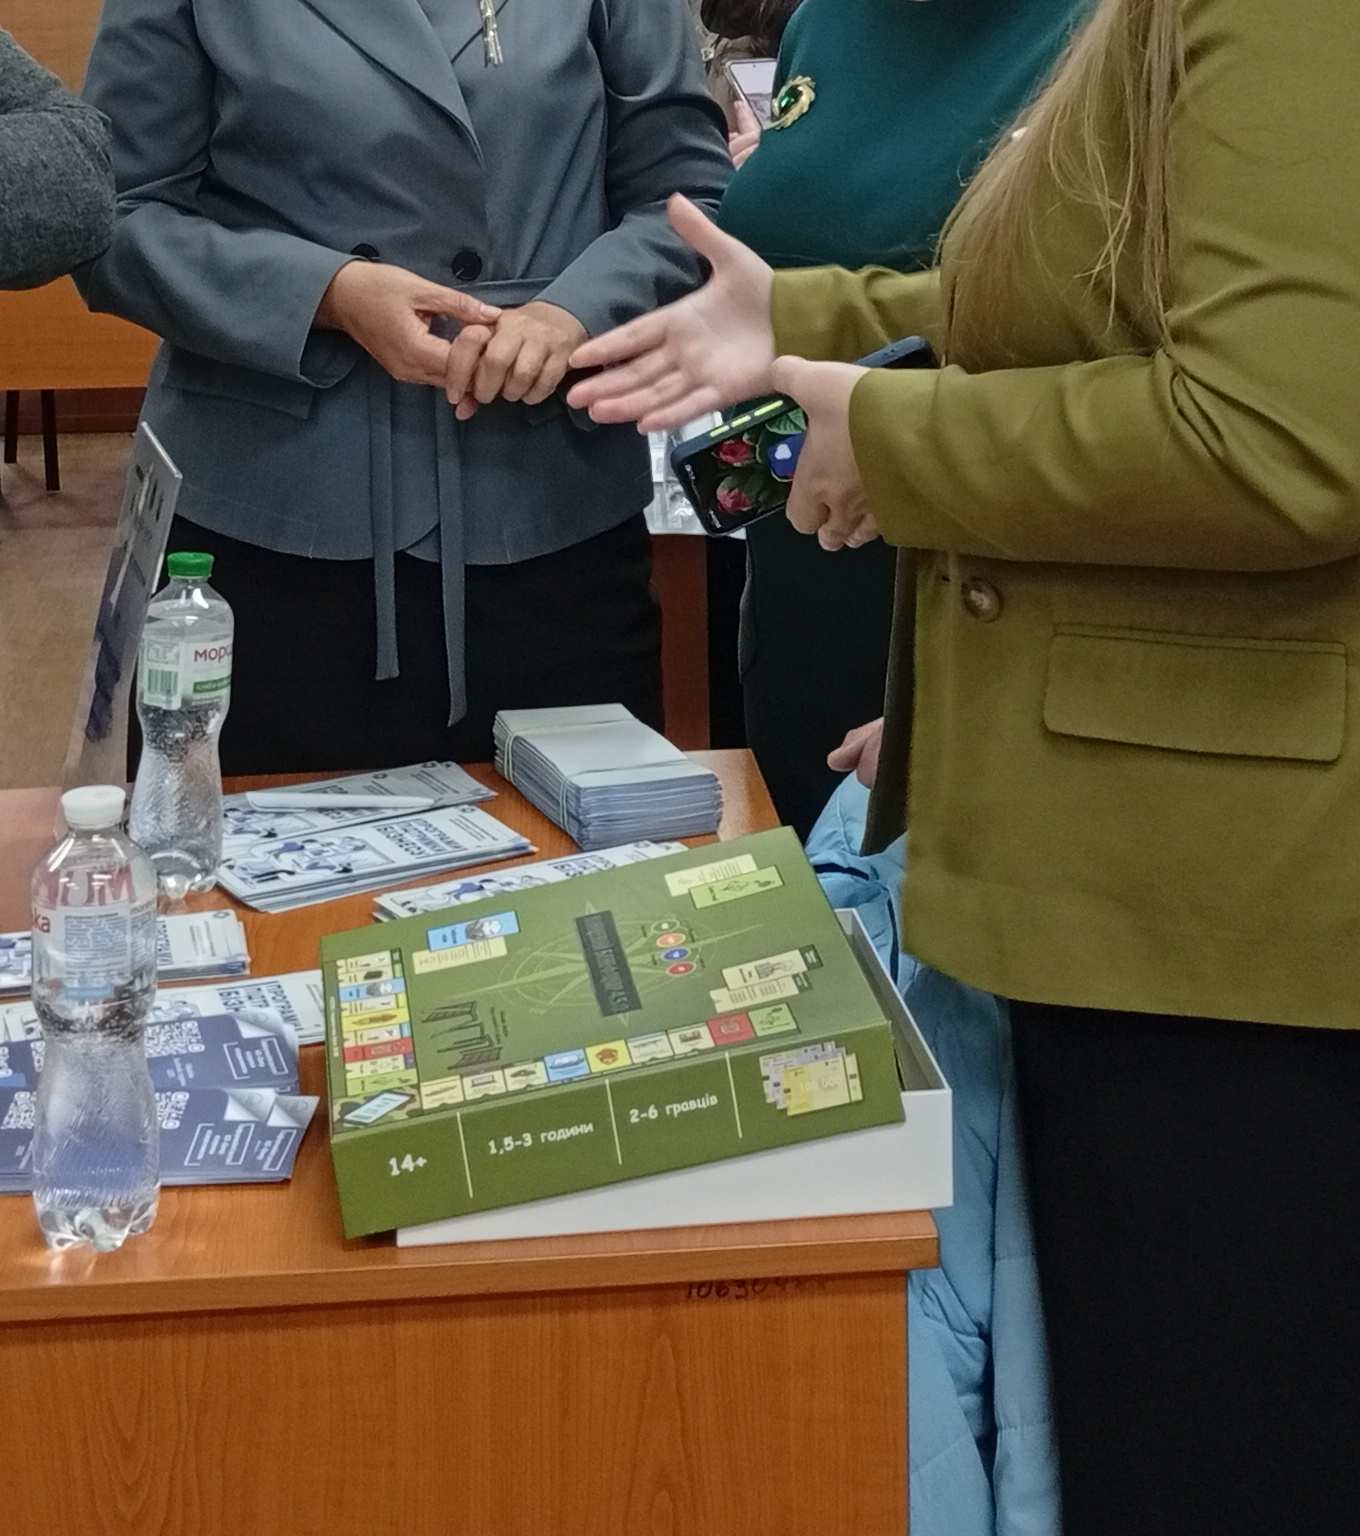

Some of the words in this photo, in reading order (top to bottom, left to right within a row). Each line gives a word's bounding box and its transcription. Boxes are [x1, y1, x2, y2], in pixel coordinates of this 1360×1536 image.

[629, 1104, 658, 1124] 2-6
[665, 1093, 718, 1118] гравців
[488, 1131, 533, 1156] 1,5-3
[540, 1121, 594, 1143] години
[387, 1154, 428, 1176] 14+
